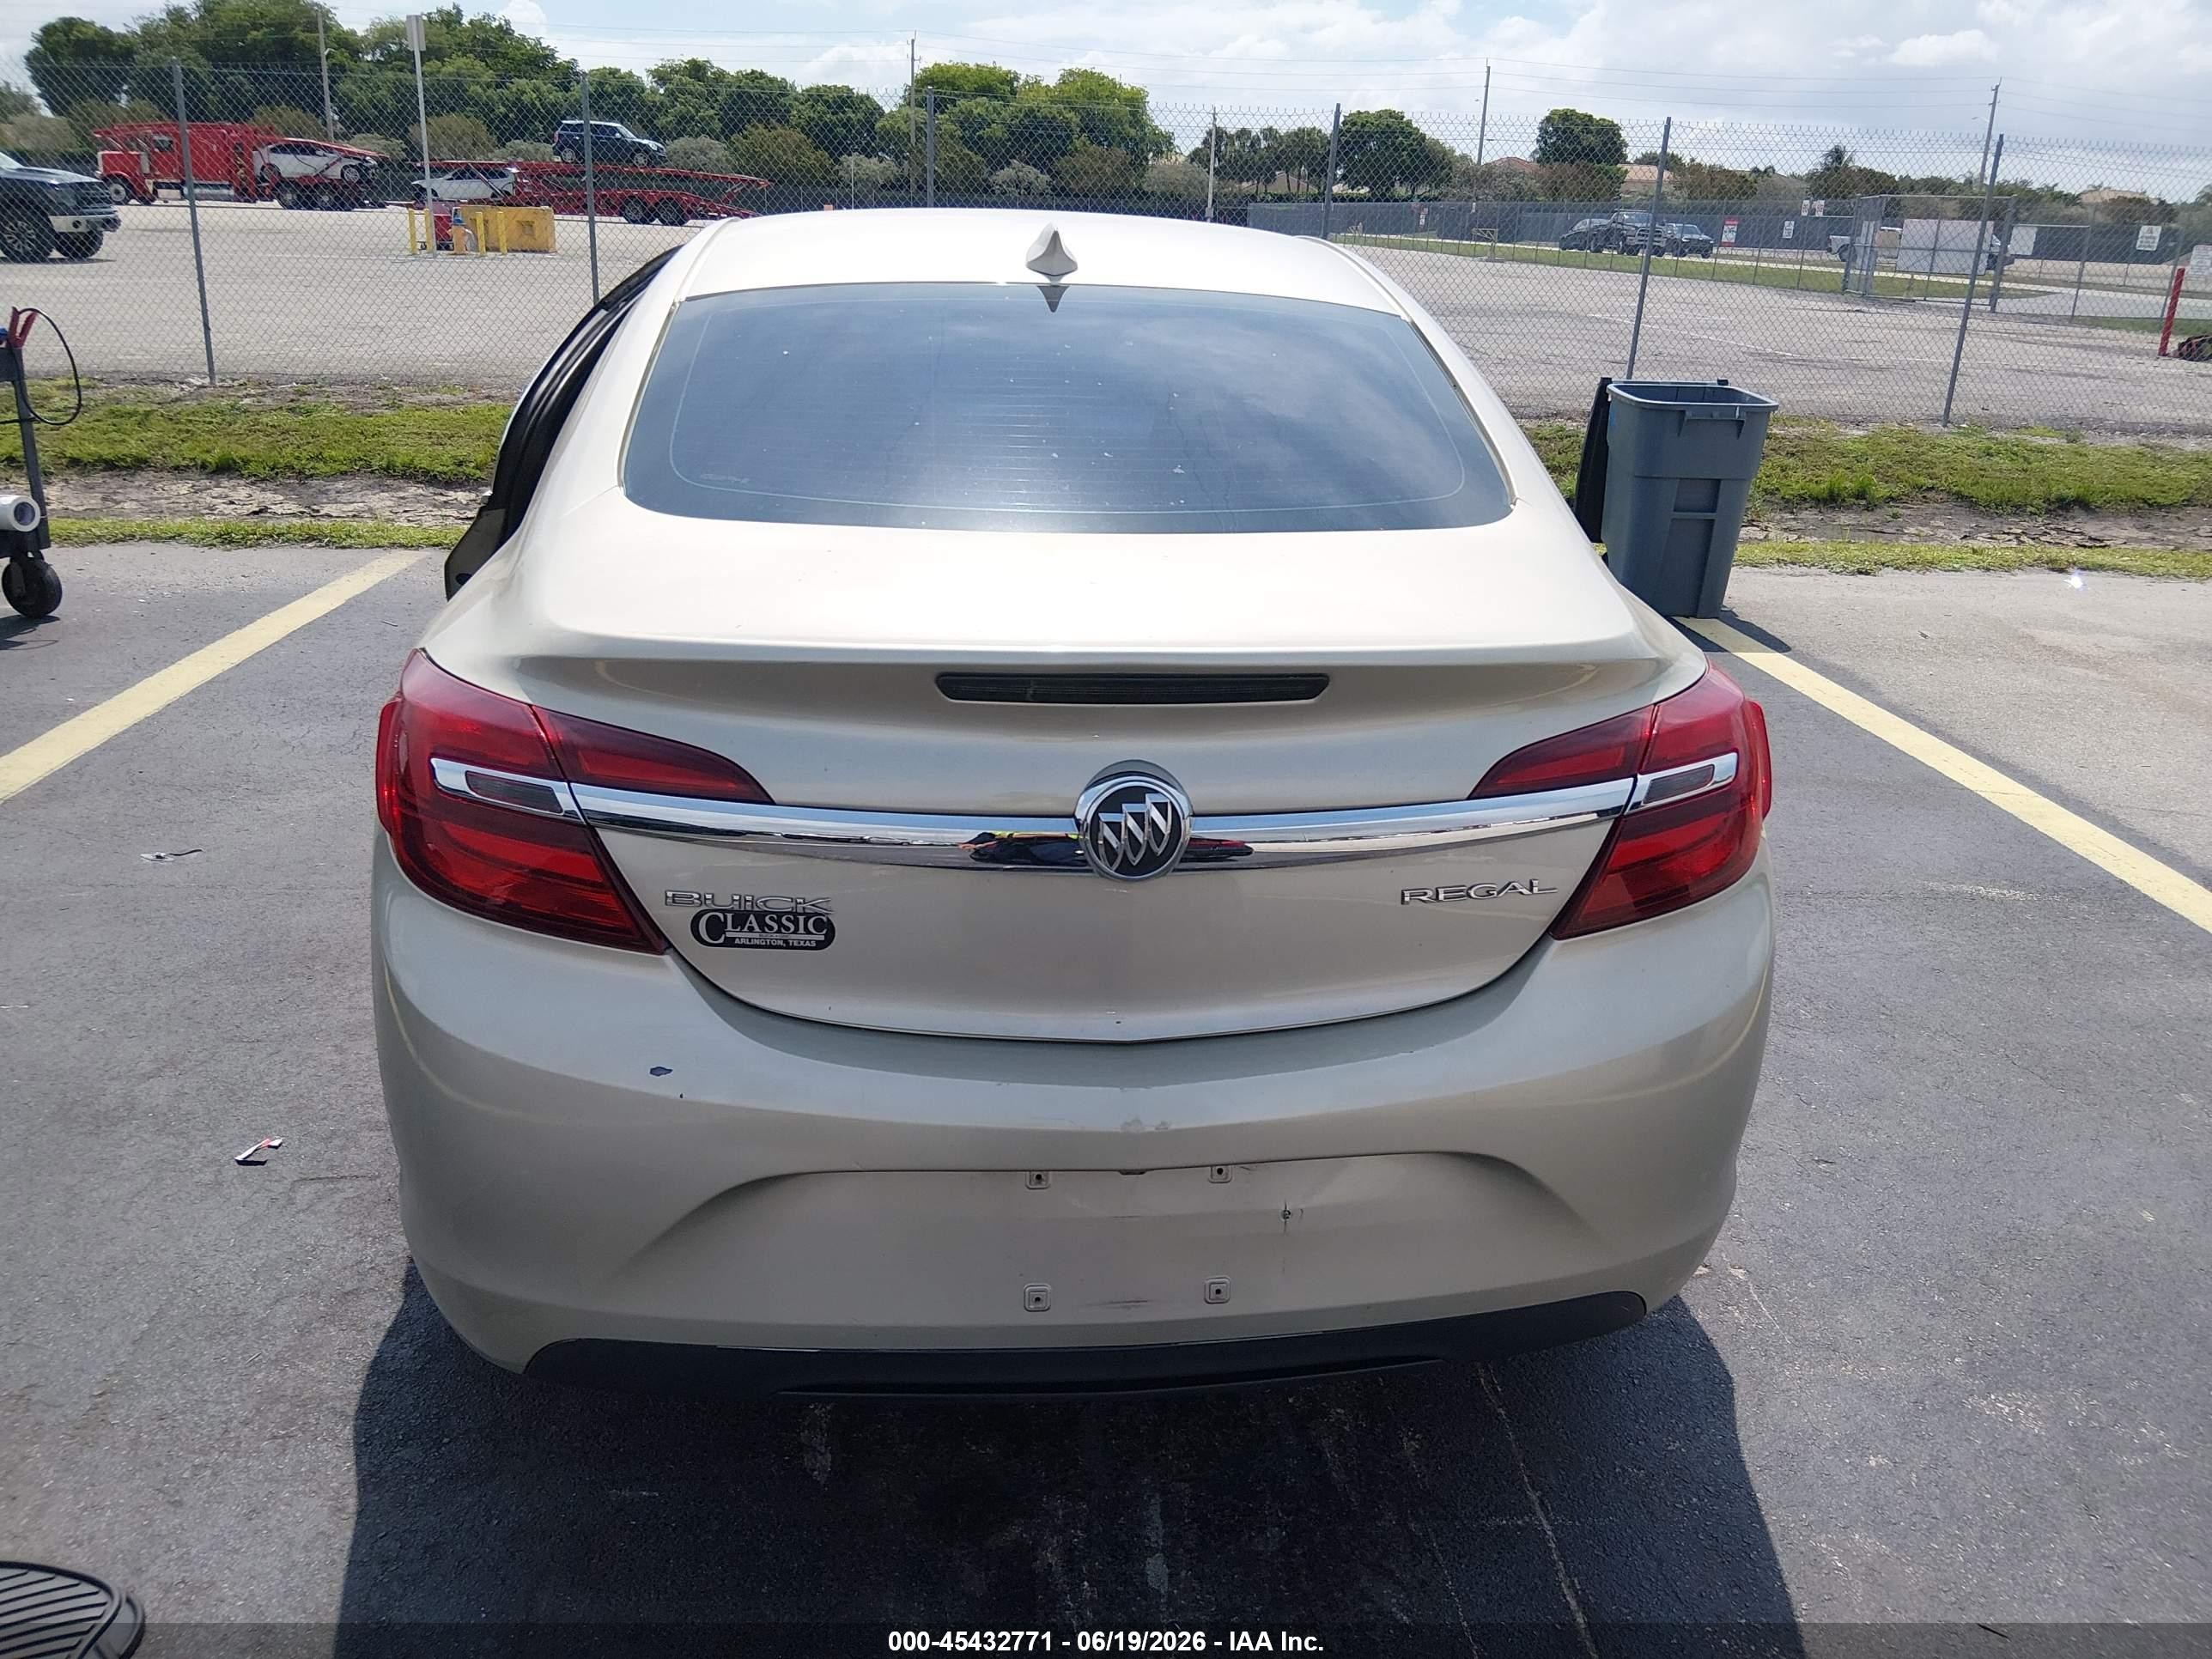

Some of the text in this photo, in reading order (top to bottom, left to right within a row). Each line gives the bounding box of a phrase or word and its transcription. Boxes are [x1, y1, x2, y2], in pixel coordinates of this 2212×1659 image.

[665, 890, 834, 914] BUICK
[1401, 878, 1559, 905] REGAL
[698, 912, 828, 944] CLASSIC
[734, 938, 786, 946] ARLINGTON,
